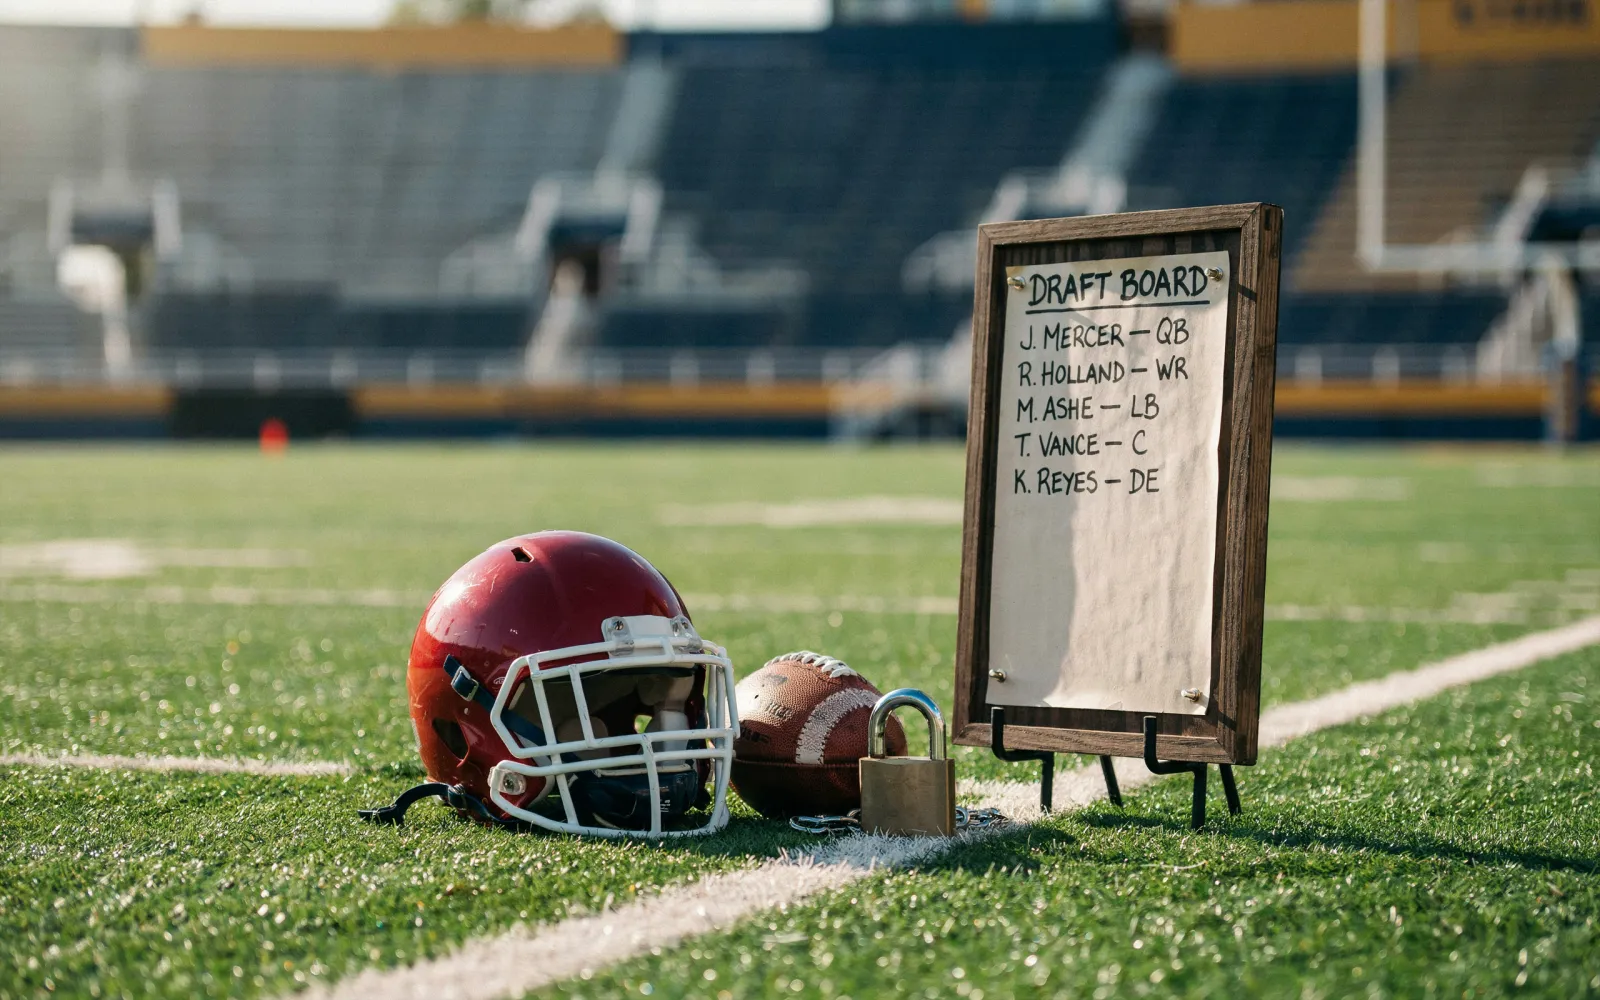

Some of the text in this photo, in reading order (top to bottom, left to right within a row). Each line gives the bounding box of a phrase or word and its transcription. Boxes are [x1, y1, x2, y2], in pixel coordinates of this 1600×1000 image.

[1028, 265, 1209, 307] DRAFT BOARD
[1020, 326, 1036, 350] J.
[1044, 322, 1124, 351] MERCER
[1157, 317, 1189, 345] QB
[1018, 362, 1036, 386] R.
[1041, 361, 1124, 386] HOLLAND
[1156, 355, 1188, 380] WR
[1017, 397, 1037, 423] M.
[1043, 396, 1093, 421] ASHE
[1131, 394, 1159, 419] LB
[1015, 433, 1031, 456] T.
[1039, 432, 1099, 457] VANCE
[1132, 430, 1147, 455] C
[1015, 469, 1031, 494] K.
[1037, 467, 1097, 495] REYES
[1129, 469, 1159, 494] DE
